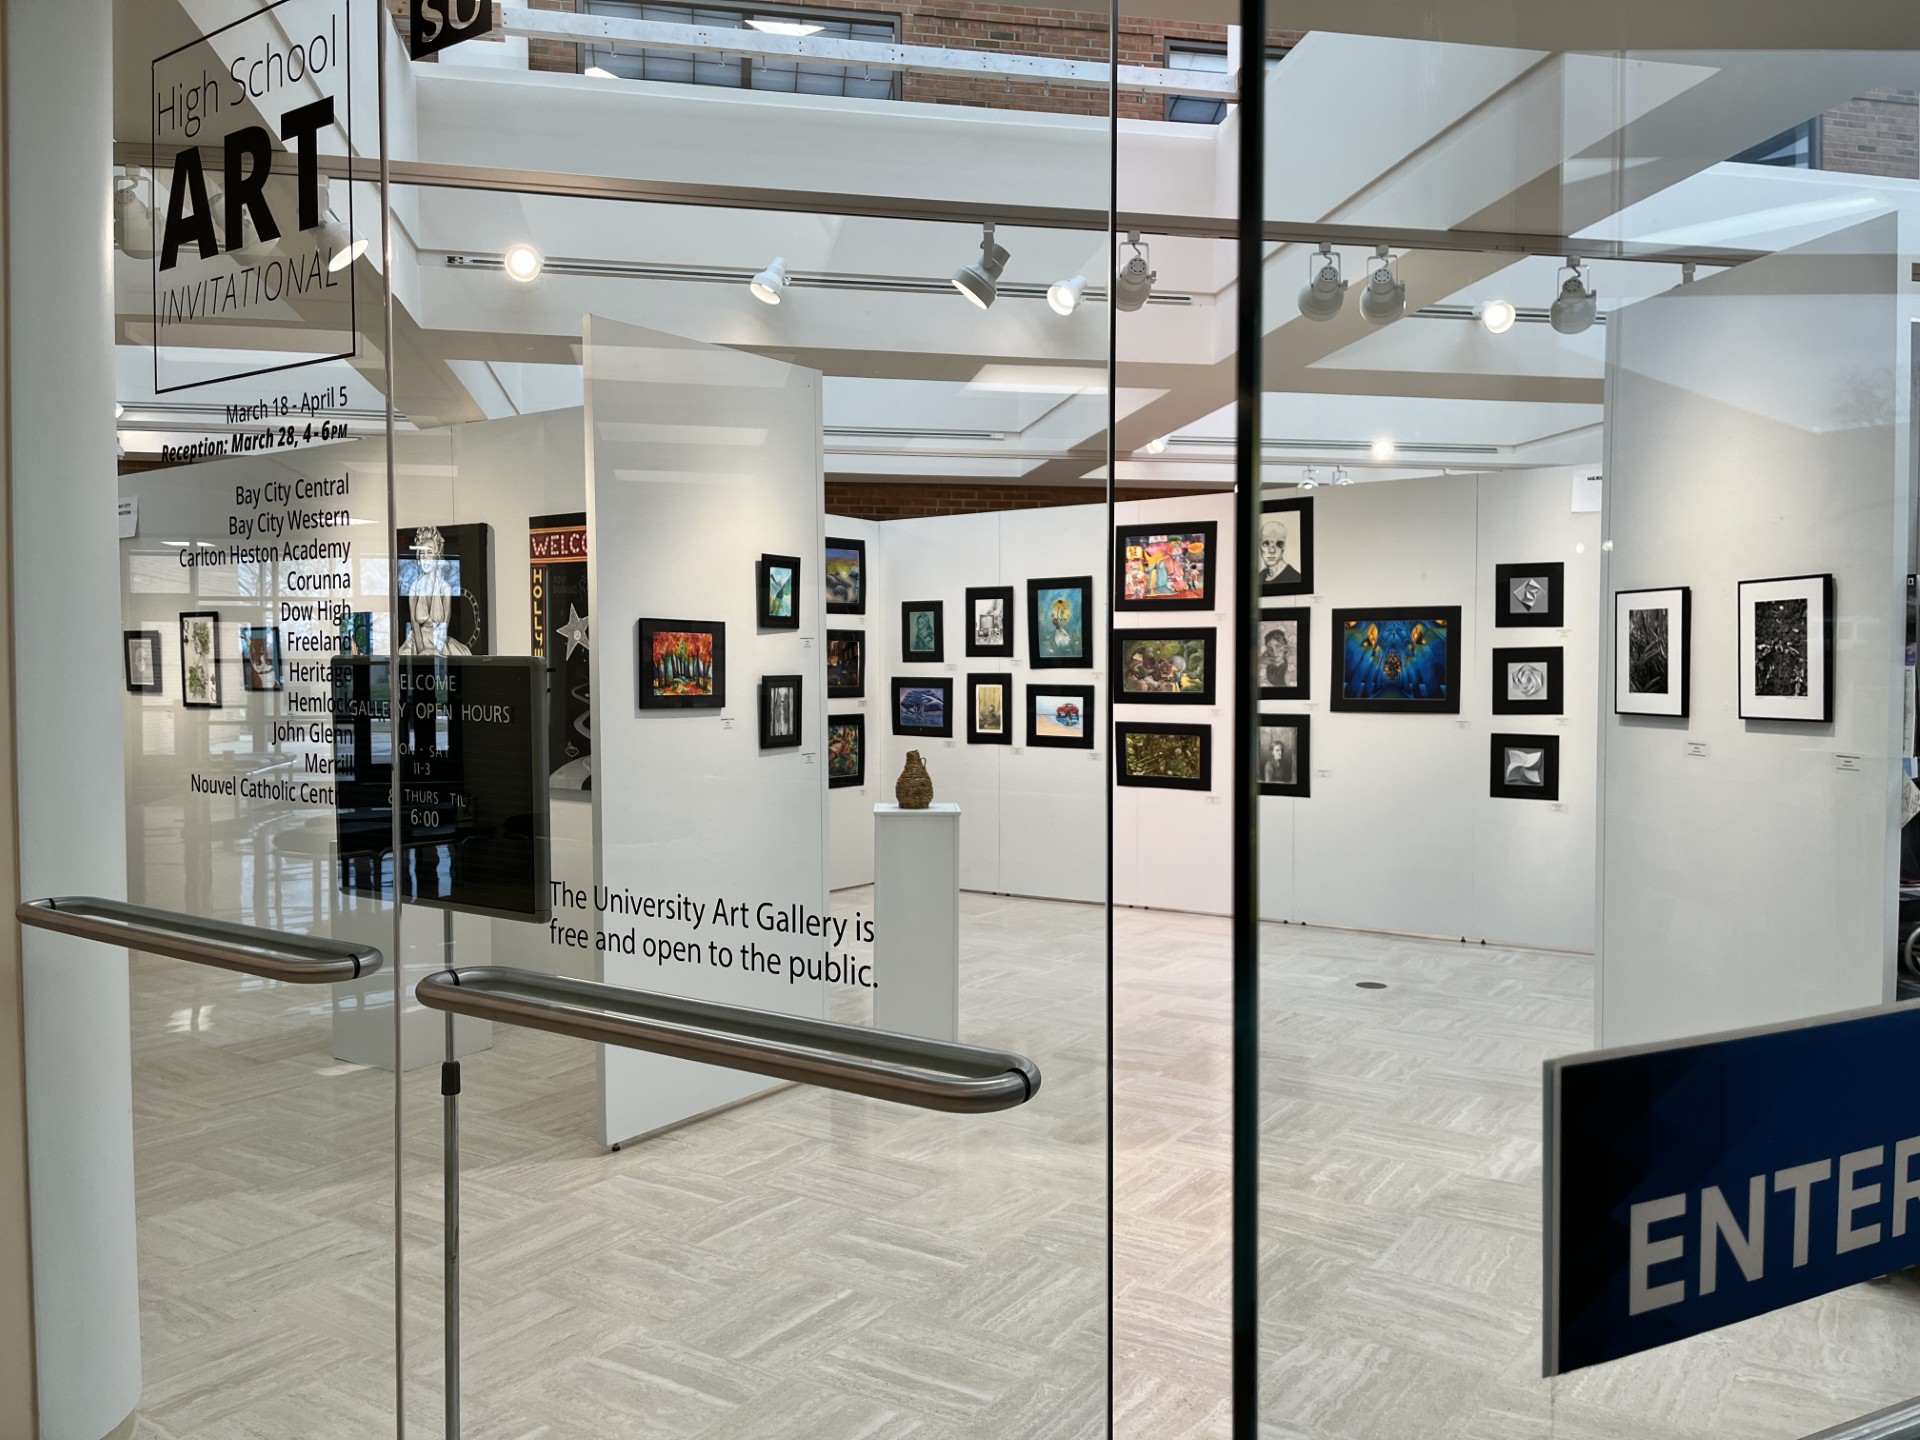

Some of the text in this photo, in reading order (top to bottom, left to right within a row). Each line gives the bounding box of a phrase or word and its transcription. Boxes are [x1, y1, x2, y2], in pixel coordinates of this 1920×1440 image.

[157, 14, 336, 137] High School
[159, 95, 334, 272] ART
[161, 247, 338, 327] INVITATIONAL
[226, 399, 268, 424] March
[273, 396, 289, 416] 18
[301, 387, 335, 417] April
[339, 386, 348, 407] 5
[162, 437, 229, 464] Reception:
[231, 428, 274, 454] March
[277, 425, 299, 448] 28,
[236, 473, 349, 509] Bay City Central
[229, 508, 350, 540] Bay City Western
[179, 538, 351, 568] Carlton Heston Academy
[287, 570, 351, 591] Corunna
[281, 599, 351, 626] Dow High
[287, 630, 351, 651] Freeland
[289, 661, 352, 688] Heritage
[389, 672, 456, 691] ELCOME
[288, 692, 351, 713] Hemlock
[349, 700, 511, 723] GALLEY OPEN HOURS
[272, 722, 353, 745] John Glenn
[304, 753, 354, 775] Merrill
[191, 774, 236, 795] Nouvel
[240, 778, 296, 802] Catholic
[404, 789, 439, 805] THURS
[449, 793, 467, 808] TIL
[410, 808, 439, 828] 6:00
[549, 881, 875, 947] The University Art Gallery is
[550, 918, 878, 988] free and open to the public.
[1629, 1135, 1920, 1317] ENTER
